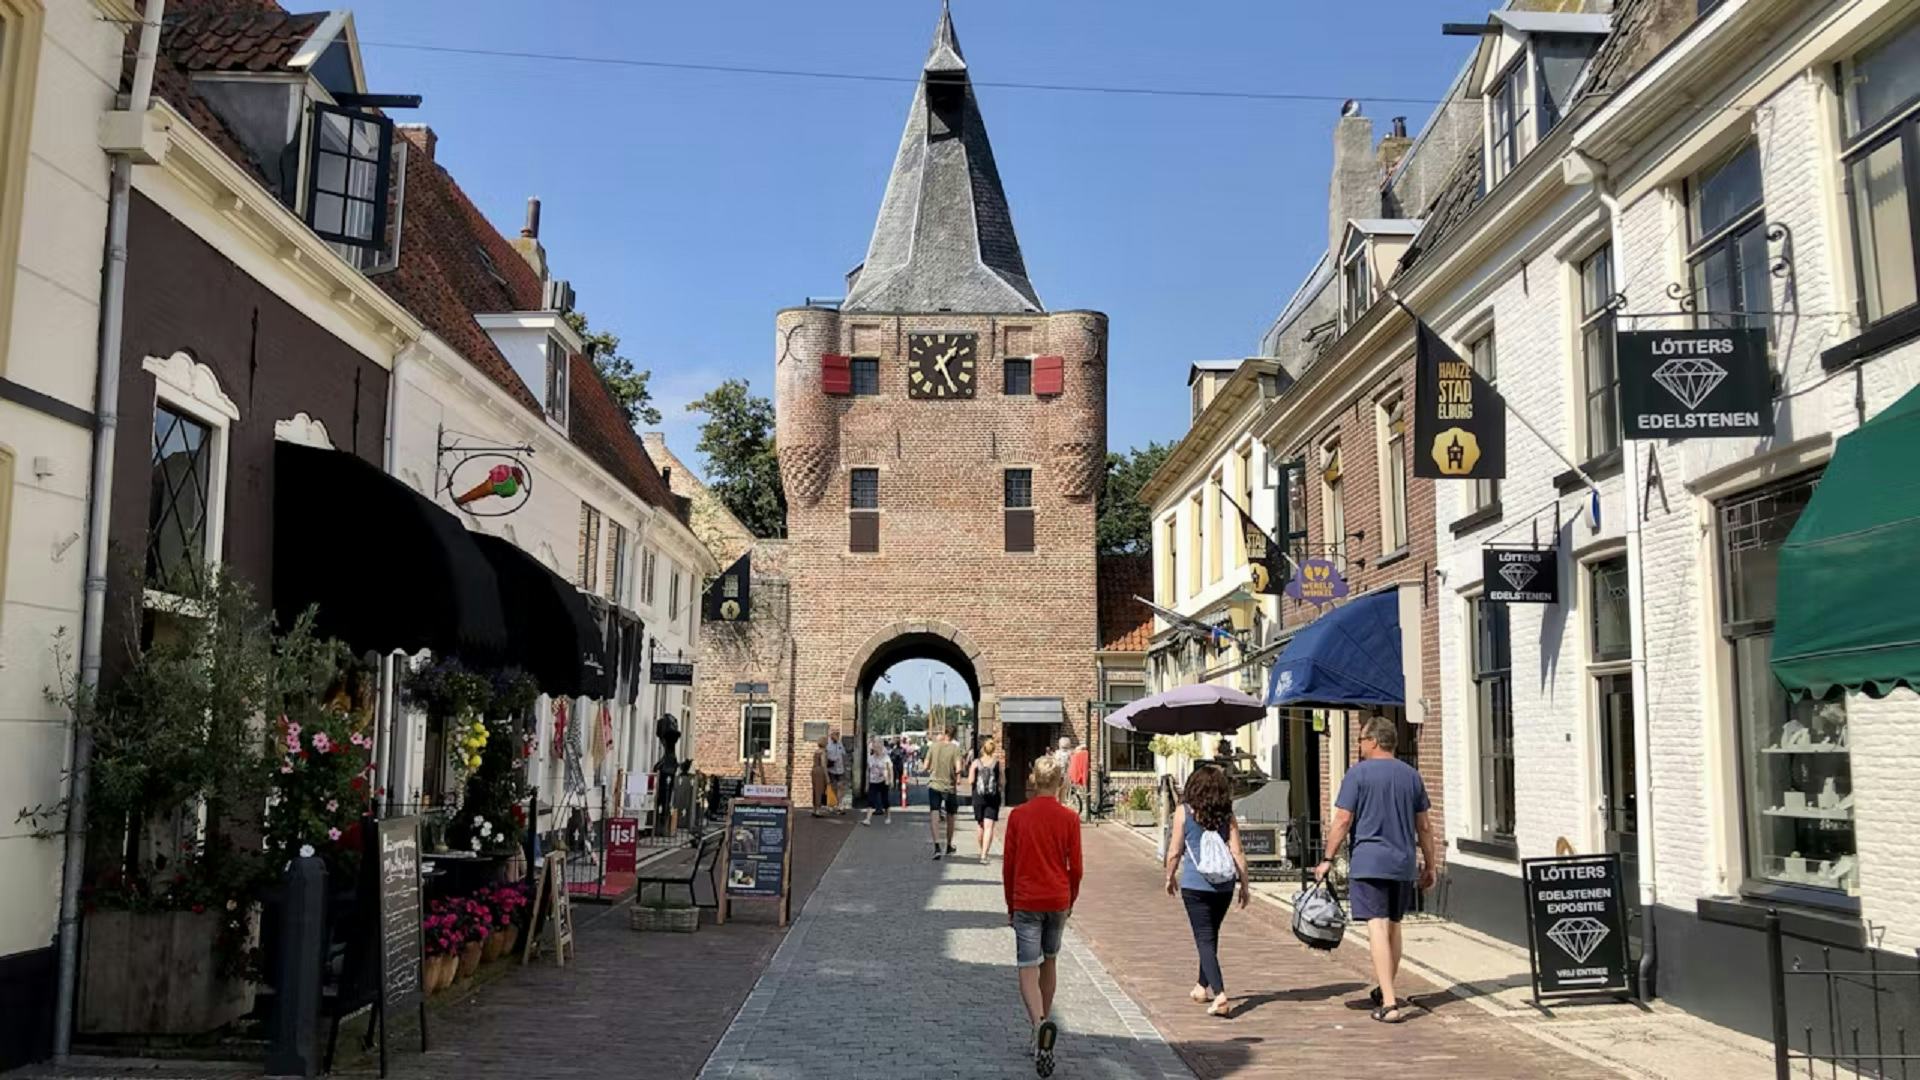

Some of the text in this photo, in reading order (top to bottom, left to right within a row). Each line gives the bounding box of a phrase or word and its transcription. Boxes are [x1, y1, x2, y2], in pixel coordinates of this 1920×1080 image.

[1651, 337, 1734, 355] LÖTTERS
[1438, 362, 1471, 378] HANZE
[1438, 380, 1472, 403] STAD
[1438, 403, 1473, 420] ELBURG
[1638, 412, 1759, 429] EDELSTENEN
[1498, 551, 1541, 563] LÖTTERS
[1490, 590, 1552, 601] EDELSTENEN
[610, 824, 636, 846] ijs!
[1540, 865, 1606, 882] LÖTTERS
[1538, 887, 1612, 901] EDELSTENEN
[1547, 901, 1605, 915] EXPOSITIE
